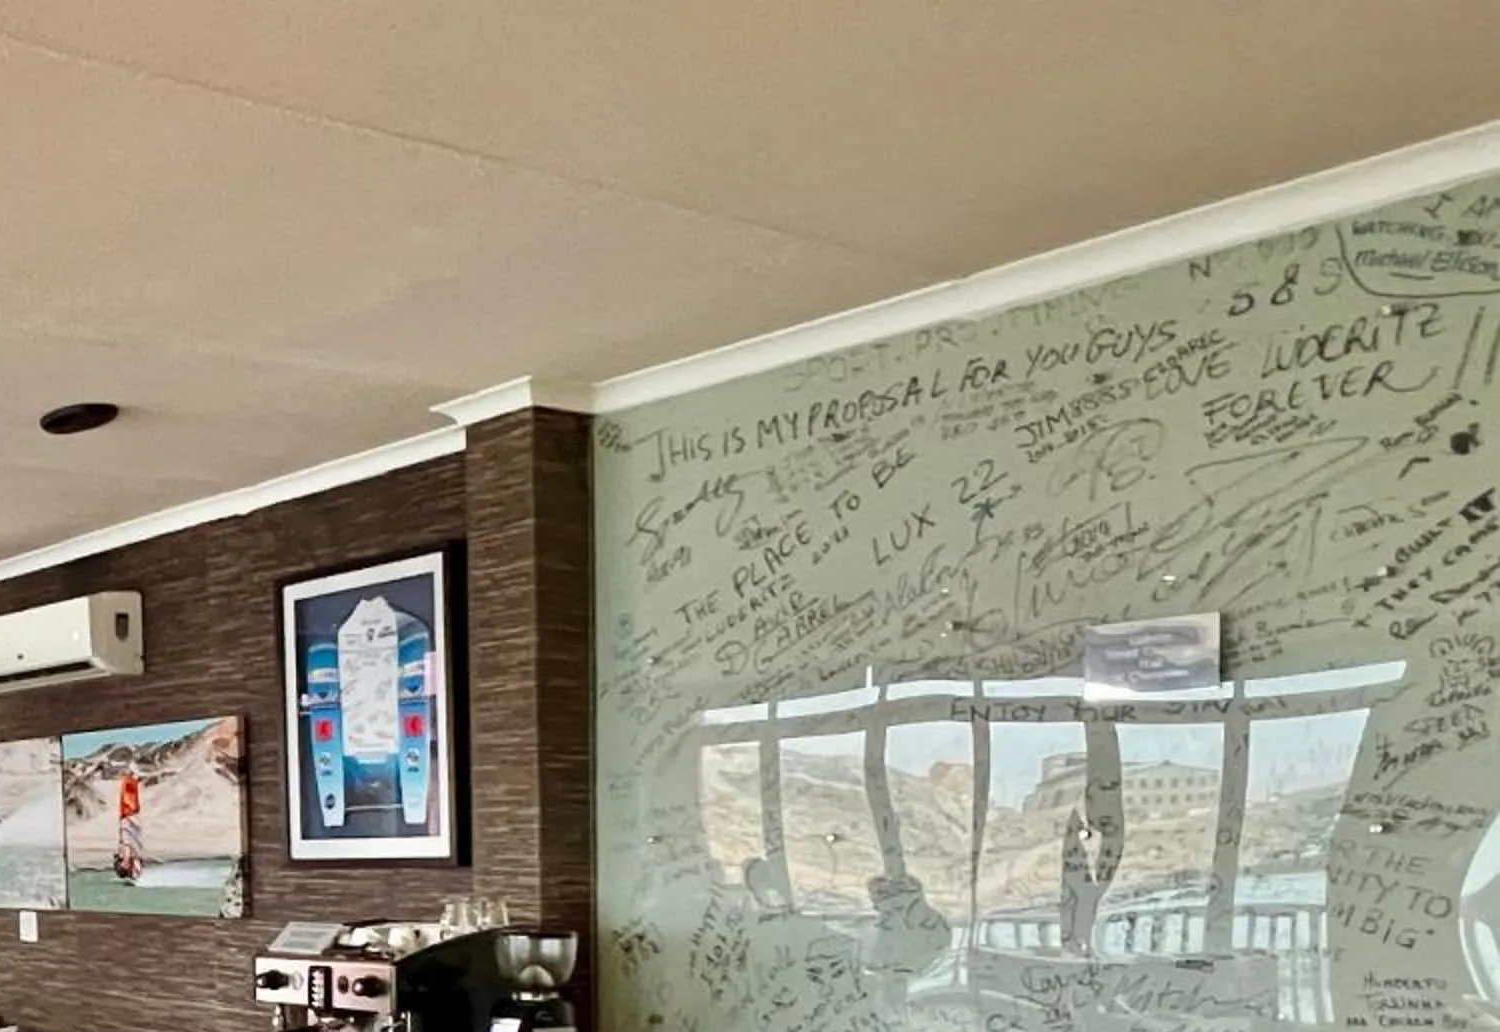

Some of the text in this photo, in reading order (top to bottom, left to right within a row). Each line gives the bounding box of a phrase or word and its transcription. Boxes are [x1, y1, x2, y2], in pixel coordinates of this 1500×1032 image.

[634, 427, 713, 483] THIS
[721, 423, 748, 457] IS
[757, 410, 800, 450] MY
[806, 371, 947, 436] PROPOSAL
[958, 357, 1009, 394] FOR
[1025, 342, 1080, 379] YOU
[1084, 319, 1178, 365] GUYS
[675, 589, 720, 624] THE
[732, 522, 812, 598] PLACE
[829, 492, 862, 521] TO
[871, 449, 917, 488] BE
[872, 504, 937, 566] LUX
[950, 695, 1046, 722] ENJOY
[1066, 698, 1137, 722] YOUR
[1406, 885, 1453, 919] TO
